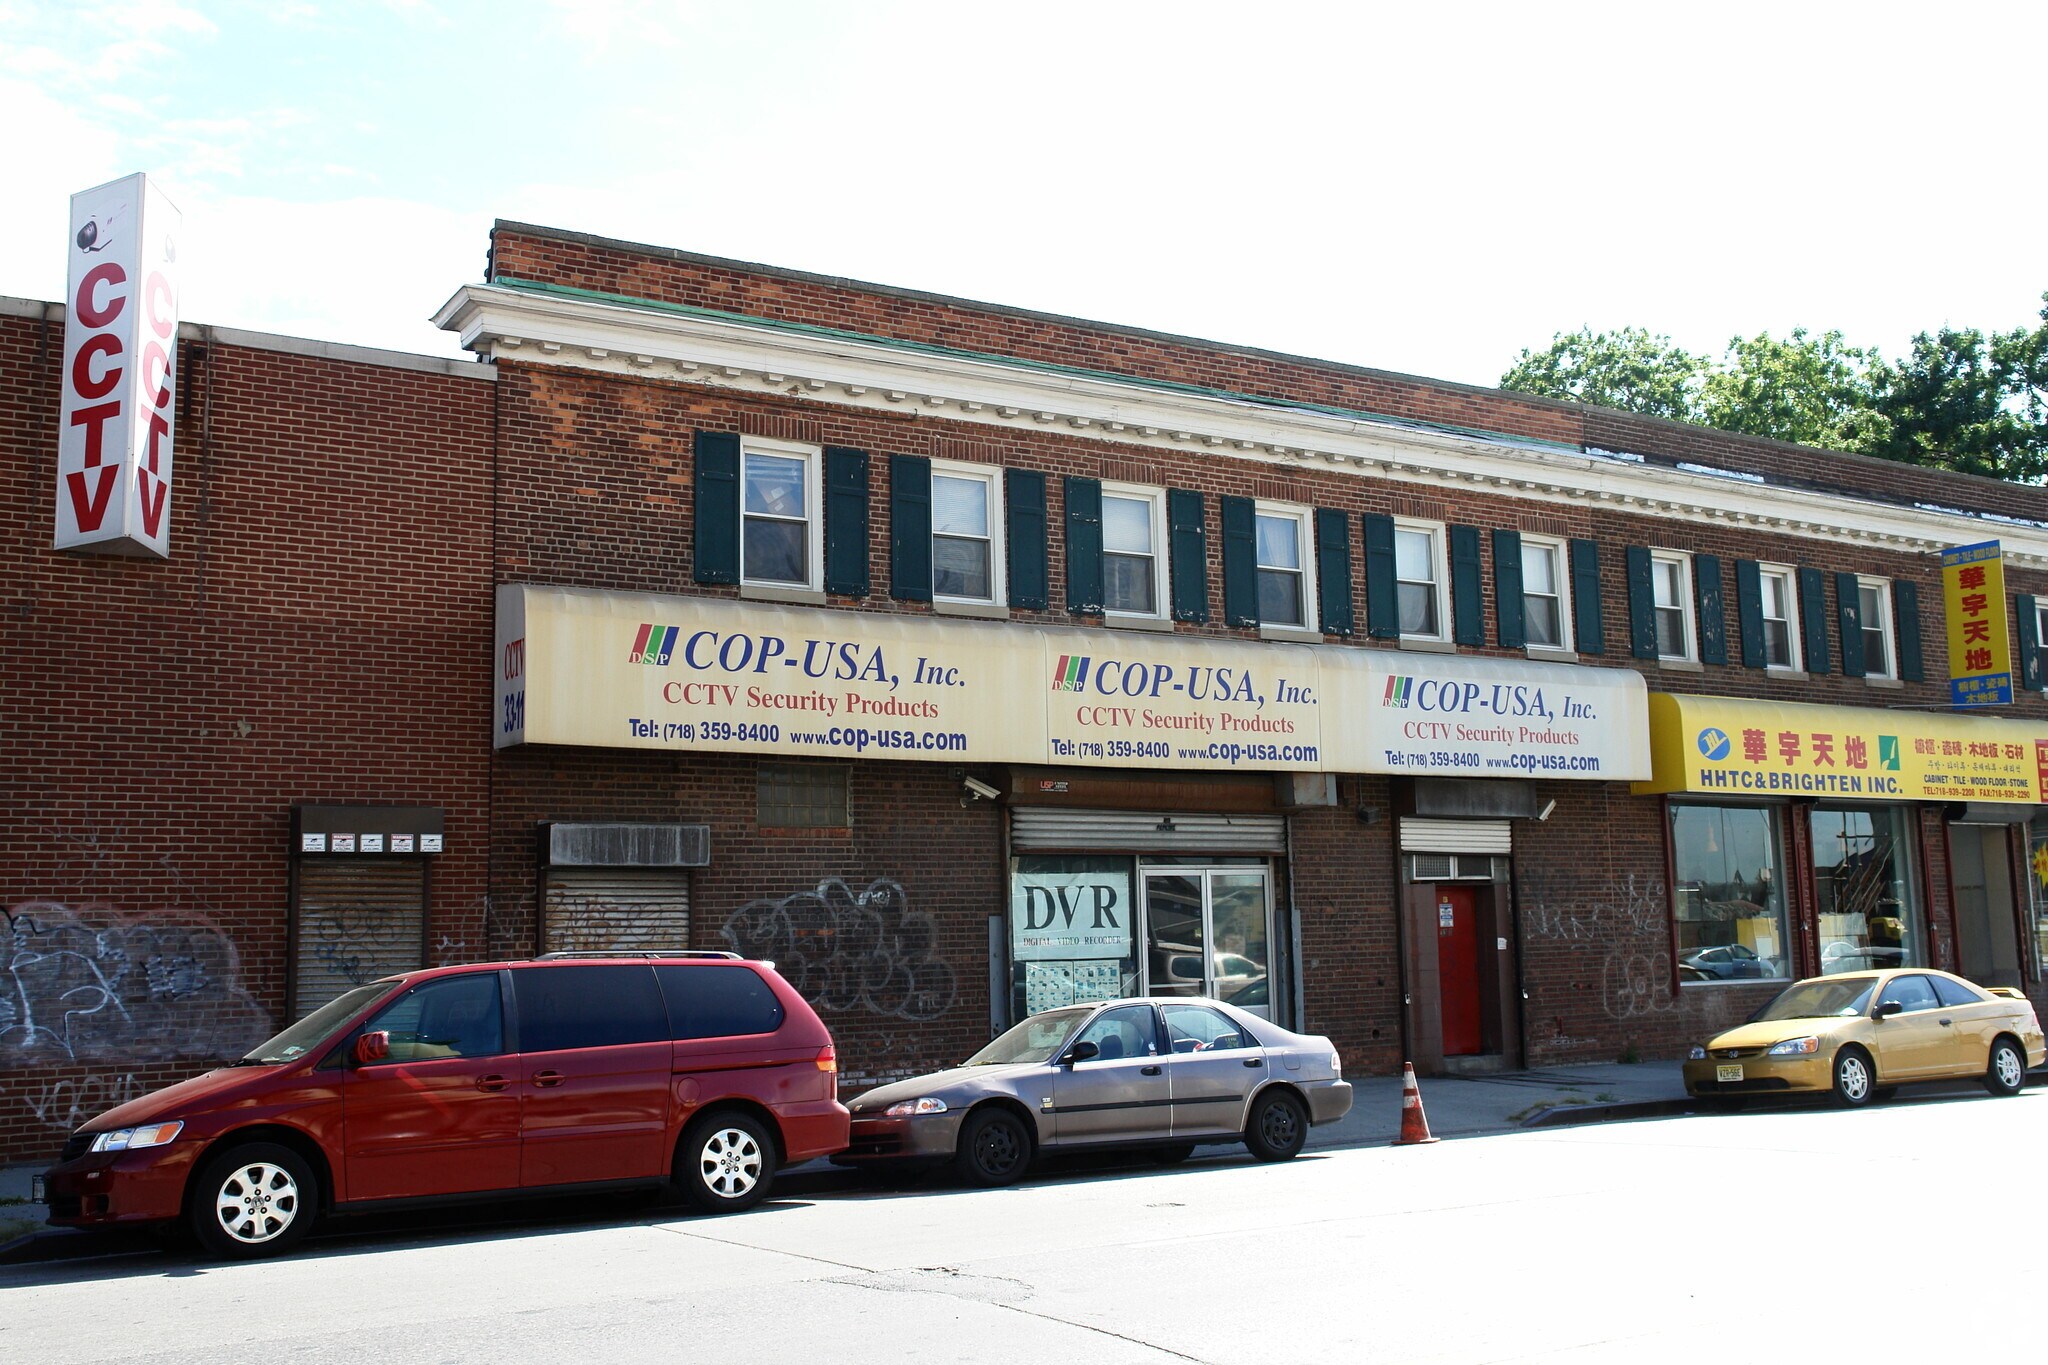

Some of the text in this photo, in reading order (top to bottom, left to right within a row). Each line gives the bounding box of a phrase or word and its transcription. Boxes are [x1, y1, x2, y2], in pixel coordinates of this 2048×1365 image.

[66, 262, 126, 533] CCTV
[138, 271, 173, 539] CCTV
[632, 652, 669, 665] DSP
[685, 631, 965, 691] COP-USA, Inc.
[663, 682, 938, 718] CCTV Security Products
[1053, 680, 1083, 691] DSP
[1095, 660, 1317, 710] COP-USA, Inc.
[1417, 679, 1597, 724] COP-USA, Inc.
[629, 718, 967, 752] Tel: (718) 359-8400 www.cop-usa.com
[1077, 705, 1295, 735] CCTV Security Products
[1404, 721, 1579, 746] CCTV Security Products
[1051, 738, 1318, 764] Tel: (718) 359-8400 www.cop-usa.com
[1385, 750, 1600, 773] Tel: (718) 359-8400 www.cop-usa.com
[1700, 769, 1903, 794] HHTC&BRIGHTEN INC.
[1924, 774, 1948, 784] CABINET
[1953, 775, 1966, 785] TILE
[1970, 776, 1987, 786] WOOD
[1989, 777, 2007, 787] FLOOR
[1022, 885, 1121, 930] DVR
[1057, 936, 1080, 945] VIDEO
